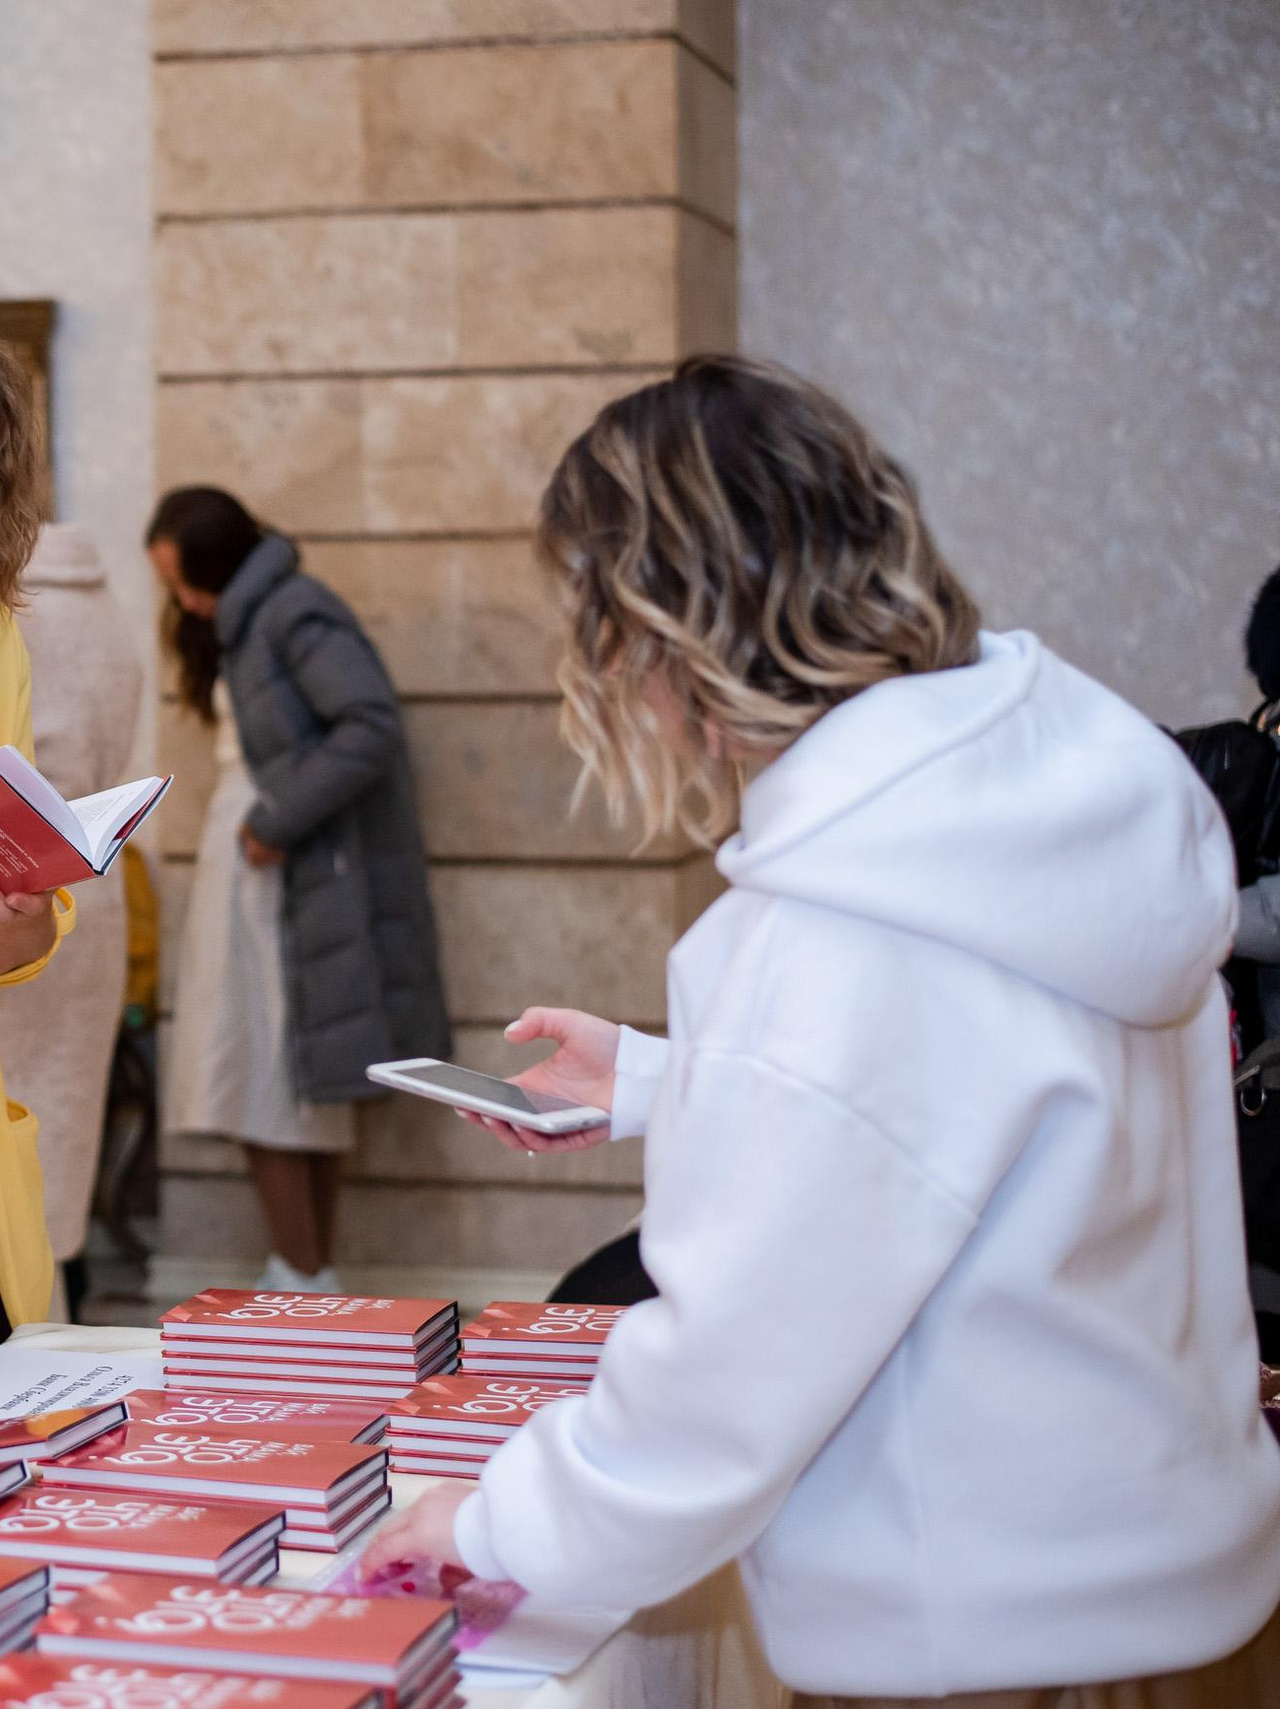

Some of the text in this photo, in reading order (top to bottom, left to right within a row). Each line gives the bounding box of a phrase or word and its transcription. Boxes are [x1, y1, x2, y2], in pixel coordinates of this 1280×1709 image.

[203, 1294, 303, 1320] ЭТО?
[284, 1297, 348, 1319] ЧТО
[502, 1307, 595, 1334] ЭТО?
[432, 1383, 540, 1414] ЭТО?
[213, 1401, 282, 1424] ЧТО
[88, 1433, 210, 1464] ЭТО?
[183, 1439, 261, 1464] ЧТО
[231, 1441, 289, 1463] МАМА,
[65, 1501, 151, 1531] ЧТО
[211, 1592, 304, 1633] ЧТО
